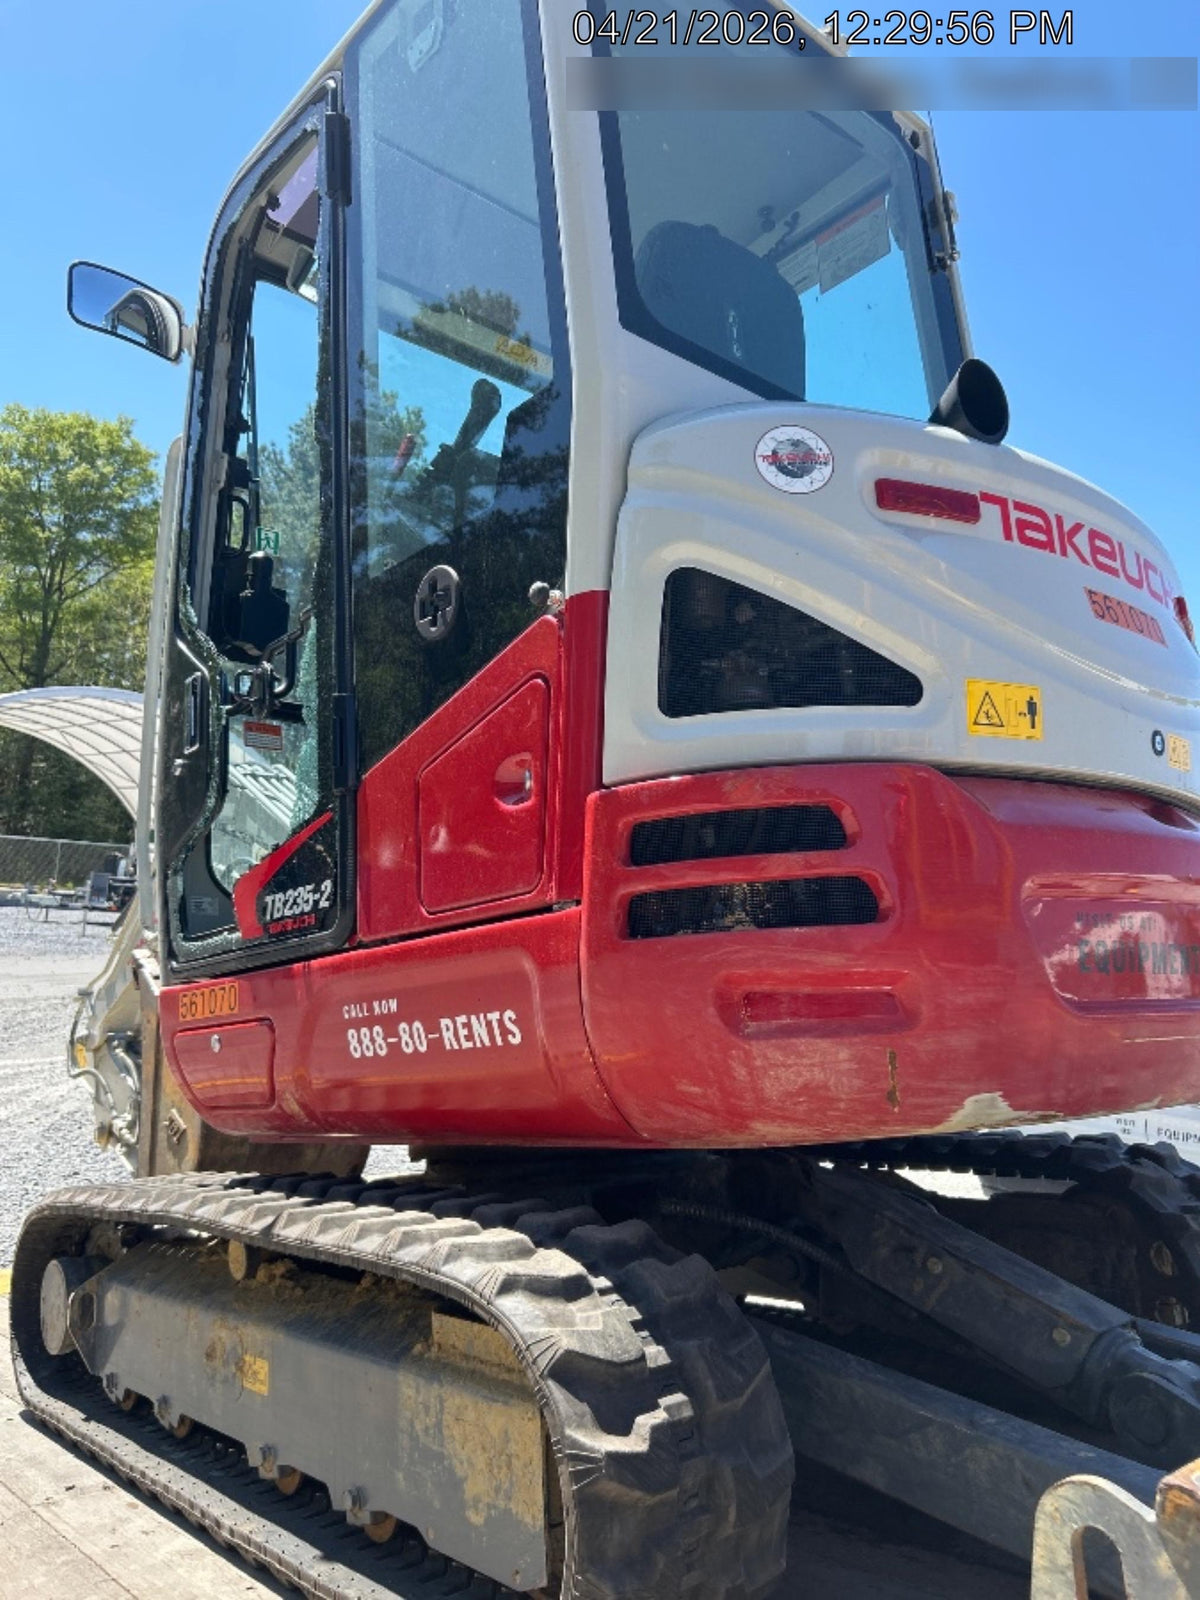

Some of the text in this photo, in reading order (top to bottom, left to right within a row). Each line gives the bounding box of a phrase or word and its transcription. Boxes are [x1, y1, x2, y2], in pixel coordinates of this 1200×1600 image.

[265, 879, 332, 920] TB235-2
[180, 984, 238, 1019] 561070
[343, 999, 398, 1019] CALL NOW
[347, 1009, 522, 1059] 888-80-RENTS
